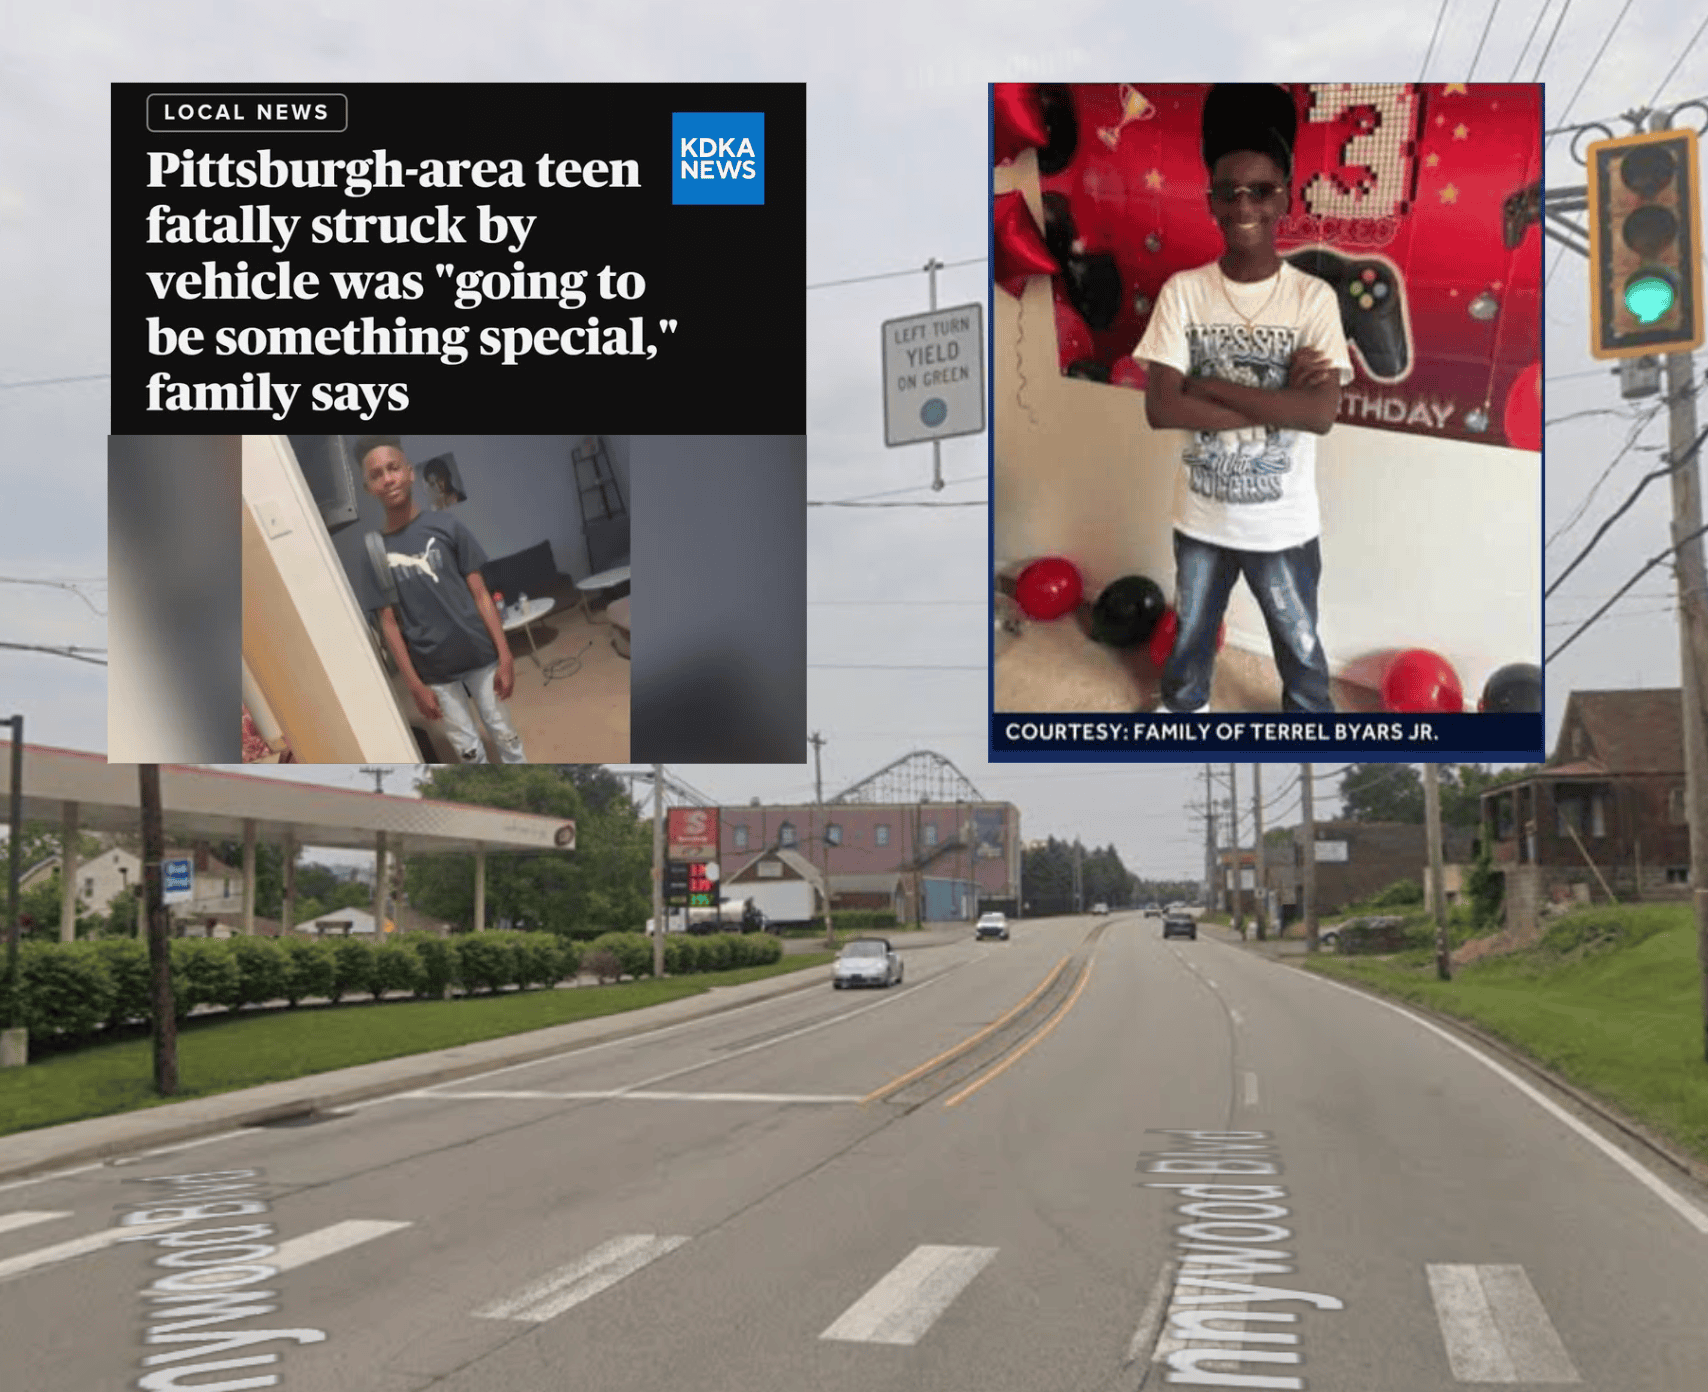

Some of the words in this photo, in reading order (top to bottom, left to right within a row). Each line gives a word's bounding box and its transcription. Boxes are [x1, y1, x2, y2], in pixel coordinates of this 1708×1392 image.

[894, 324, 926, 344] LEFT
[933, 317, 970, 338] TURN
[906, 341, 960, 368] YIELD
[897, 374, 917, 392] ON
[923, 365, 970, 388] GREEN
[1337, 392, 1455, 429] THDAY
